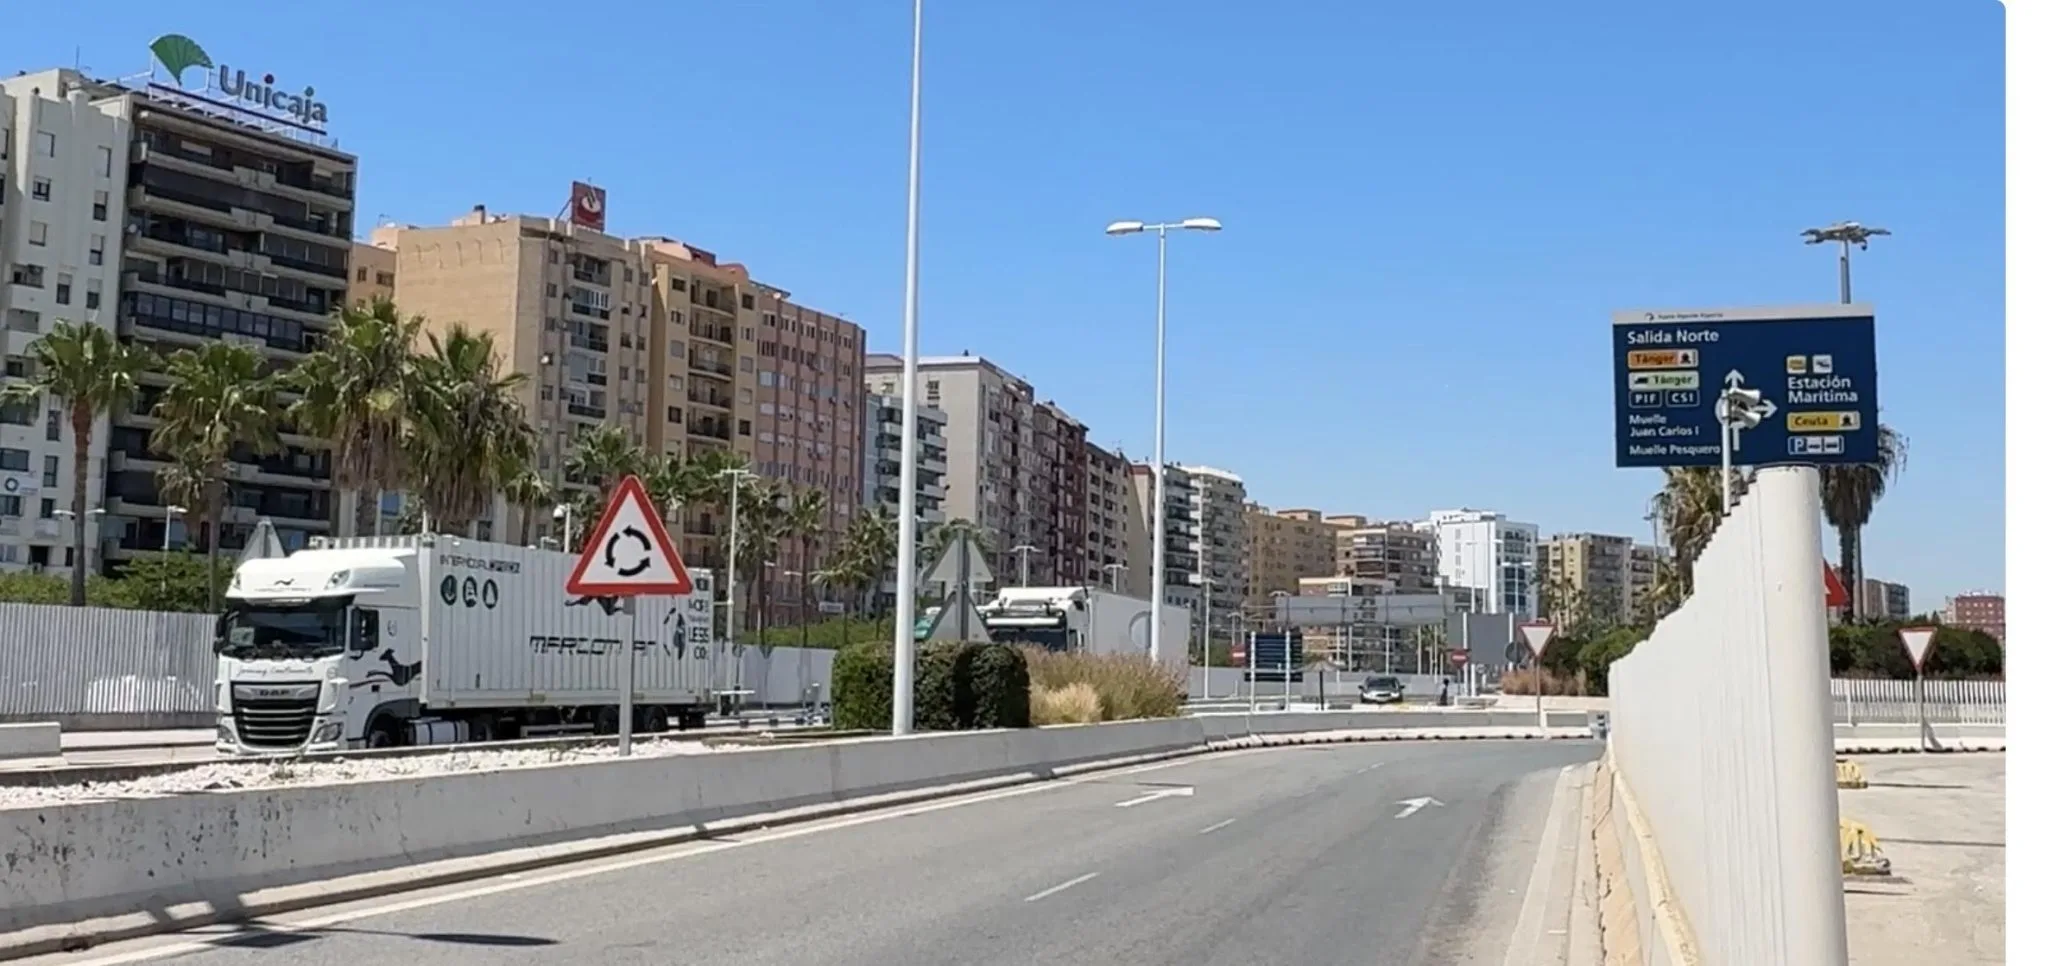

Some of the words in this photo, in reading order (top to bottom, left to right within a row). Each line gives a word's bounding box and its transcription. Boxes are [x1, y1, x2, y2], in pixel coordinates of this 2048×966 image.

[220, 64, 328, 124] Unicaja
[1627, 330, 1672, 344] Salida
[1676, 329, 1719, 343] Norte
[1788, 376, 1851, 389] Estación
[1635, 393, 1656, 403] PIF
[1671, 392, 1694, 403] CSI
[1629, 414, 1667, 424] Muelle
[1795, 416, 1828, 426] Ceuta
[1630, 427, 1656, 437] Juan
[1658, 426, 1692, 436] Carlos
[1695, 426, 1699, 435] I
[1630, 445, 1667, 455] Muelle
[1669, 444, 1721, 456] Pesquero
[1795, 438, 1805, 453] P
